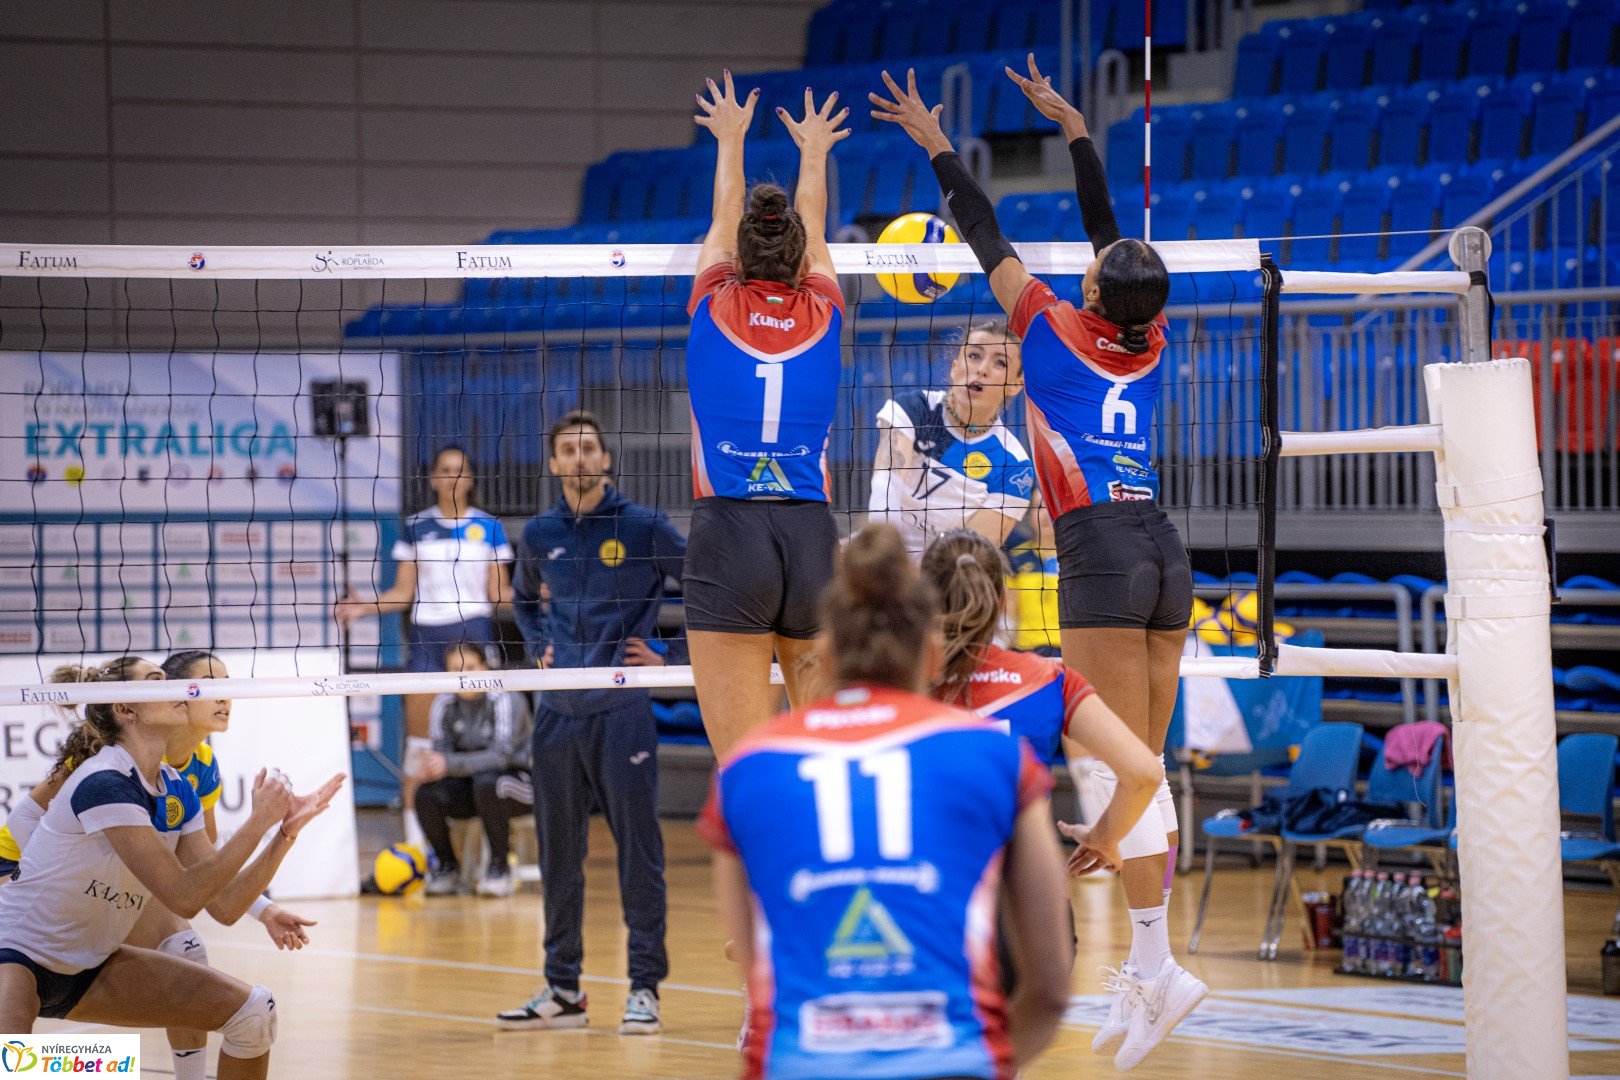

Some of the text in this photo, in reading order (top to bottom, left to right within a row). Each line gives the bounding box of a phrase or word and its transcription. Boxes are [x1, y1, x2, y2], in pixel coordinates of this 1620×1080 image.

[456, 251, 512, 268] FATUM
[749, 312, 796, 331] Kump
[755, 362, 784, 444] 1
[24, 421, 296, 458] EXTRALIGA
[911, 461, 952, 500] 17
[20, 688, 69, 703] FATUM
[457, 675, 504, 690] FATUM
[797, 748, 912, 863] 11
